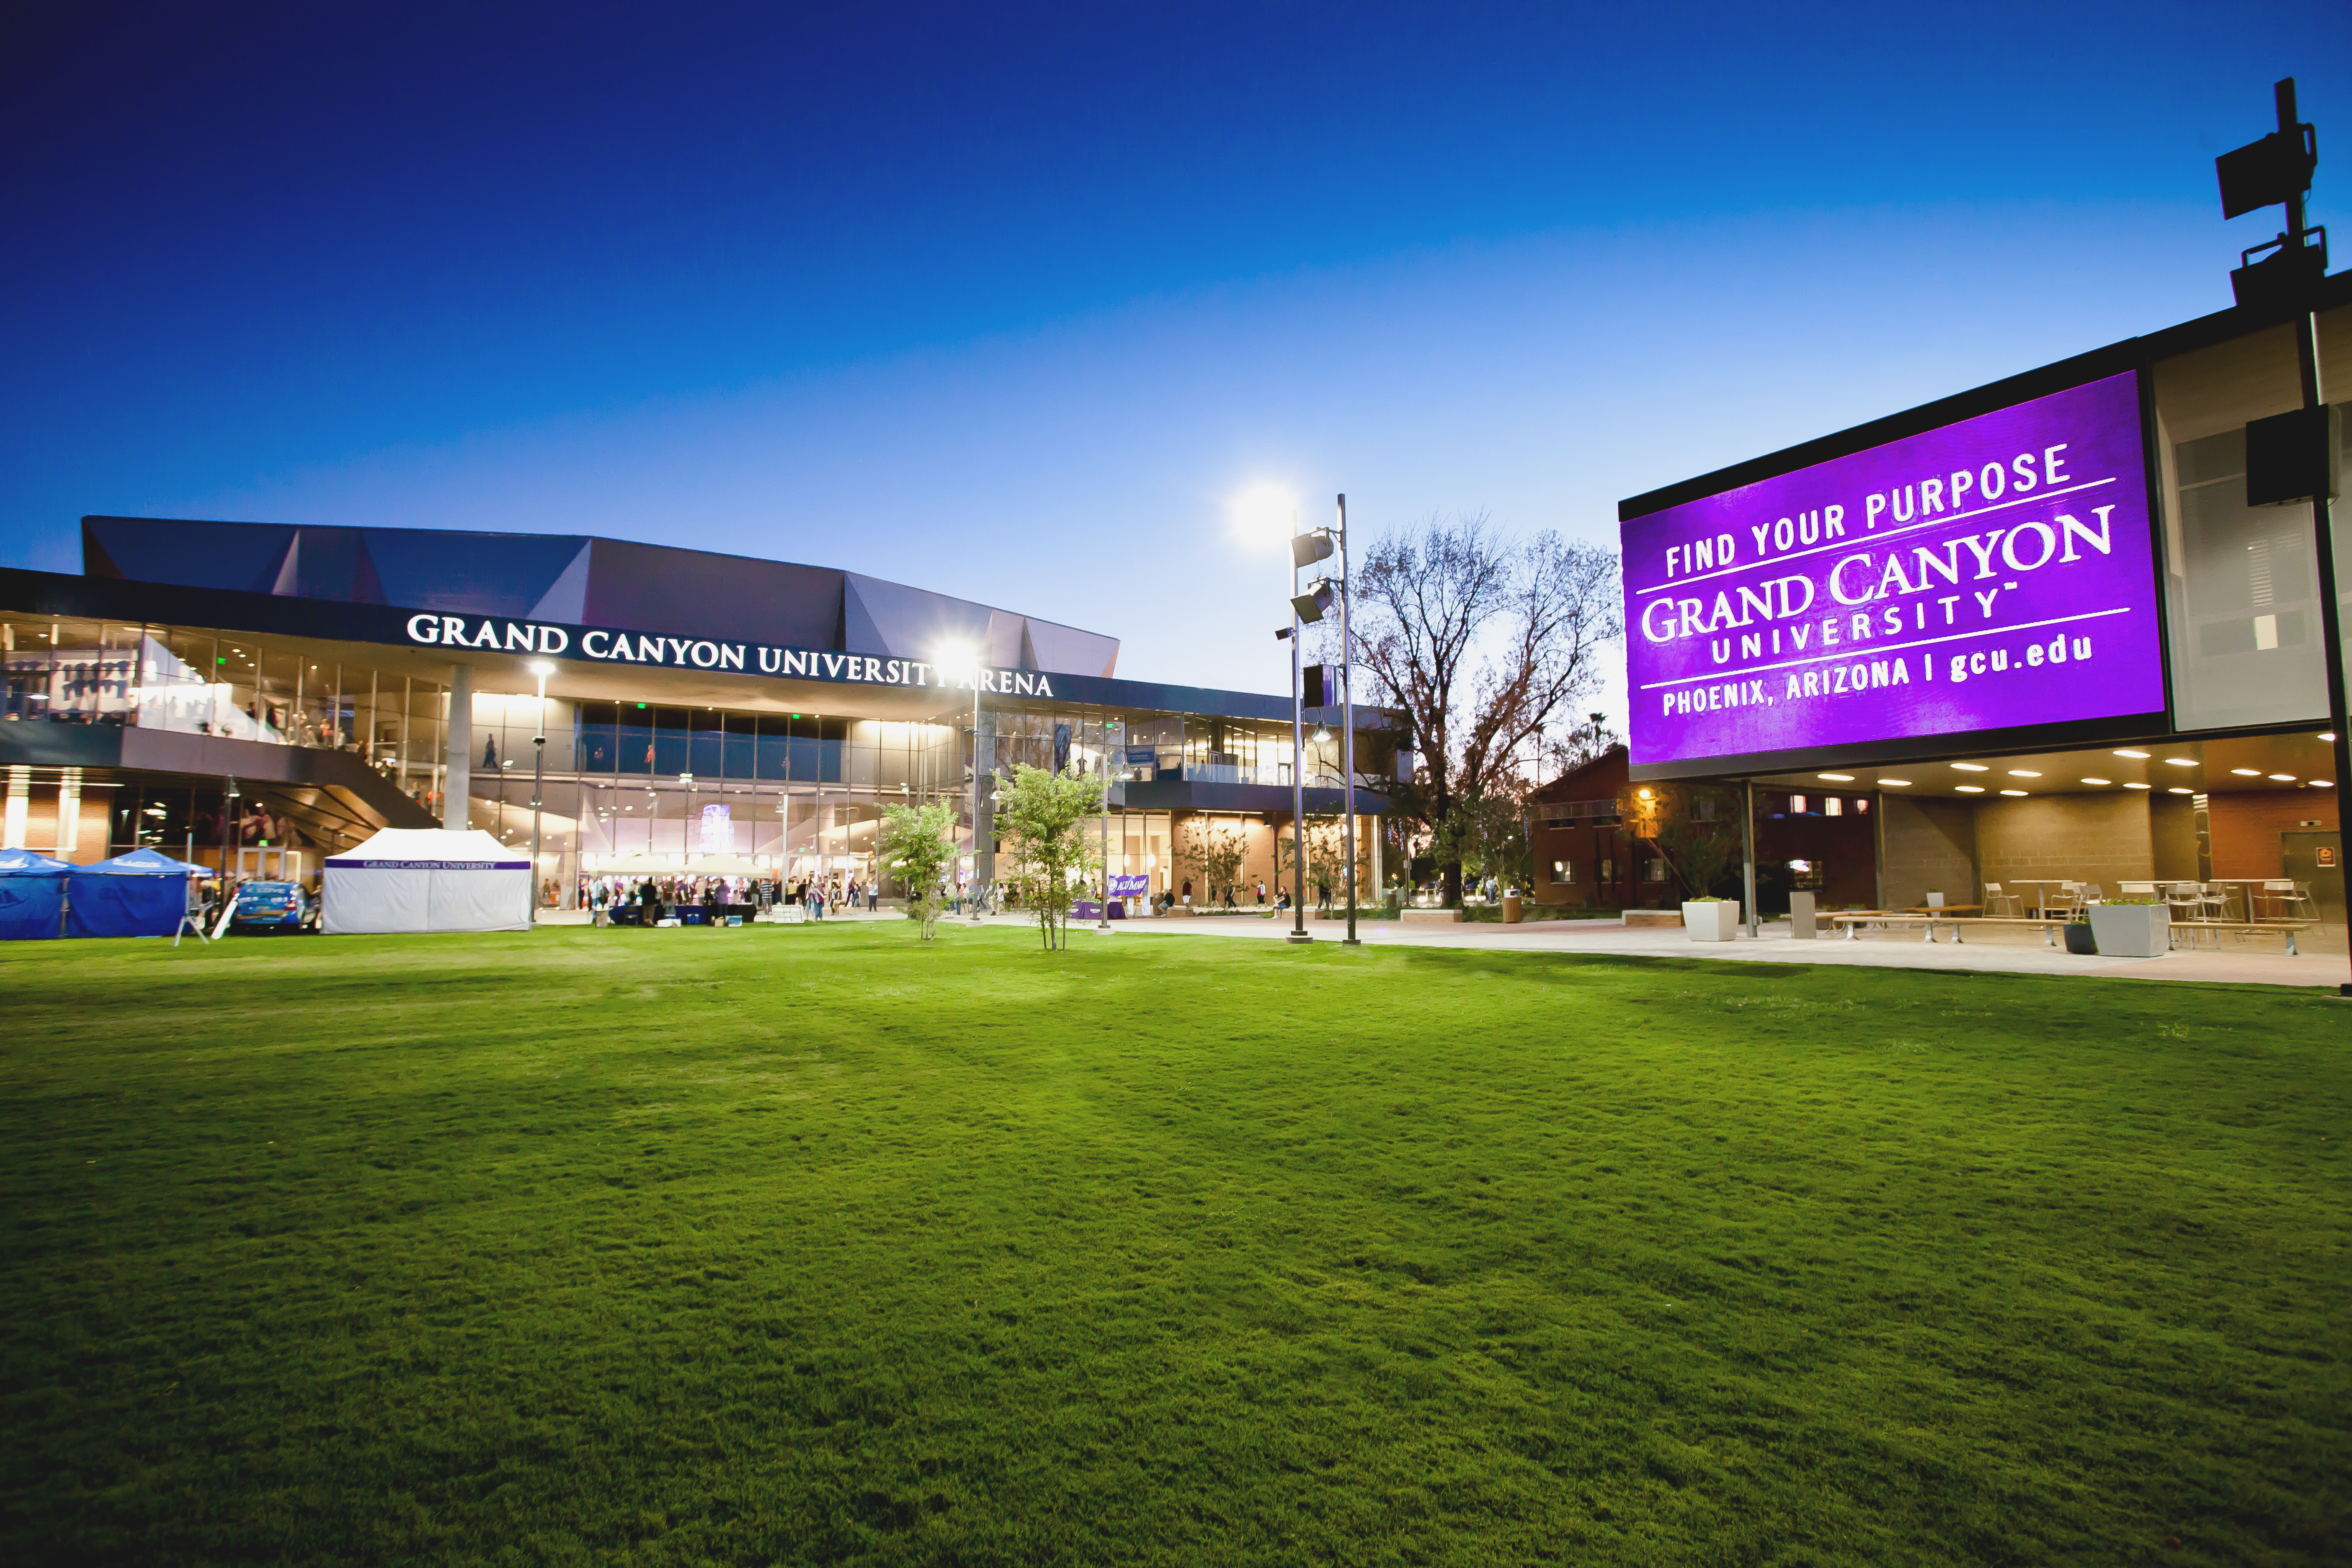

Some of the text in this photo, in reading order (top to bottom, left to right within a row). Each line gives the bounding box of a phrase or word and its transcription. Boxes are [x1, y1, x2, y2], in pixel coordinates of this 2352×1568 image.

[1666, 444, 2070, 578] FIND YOUR PURPOSE
[1642, 505, 2115, 642] GRAND CANYON
[407, 615, 568, 653] GRAND
[583, 632, 745, 669] CANYON
[1663, 680, 1773, 716] PHOENIX,
[1783, 658, 1909, 701] ARIZONA
[1951, 634, 2092, 682] gcu.edu
